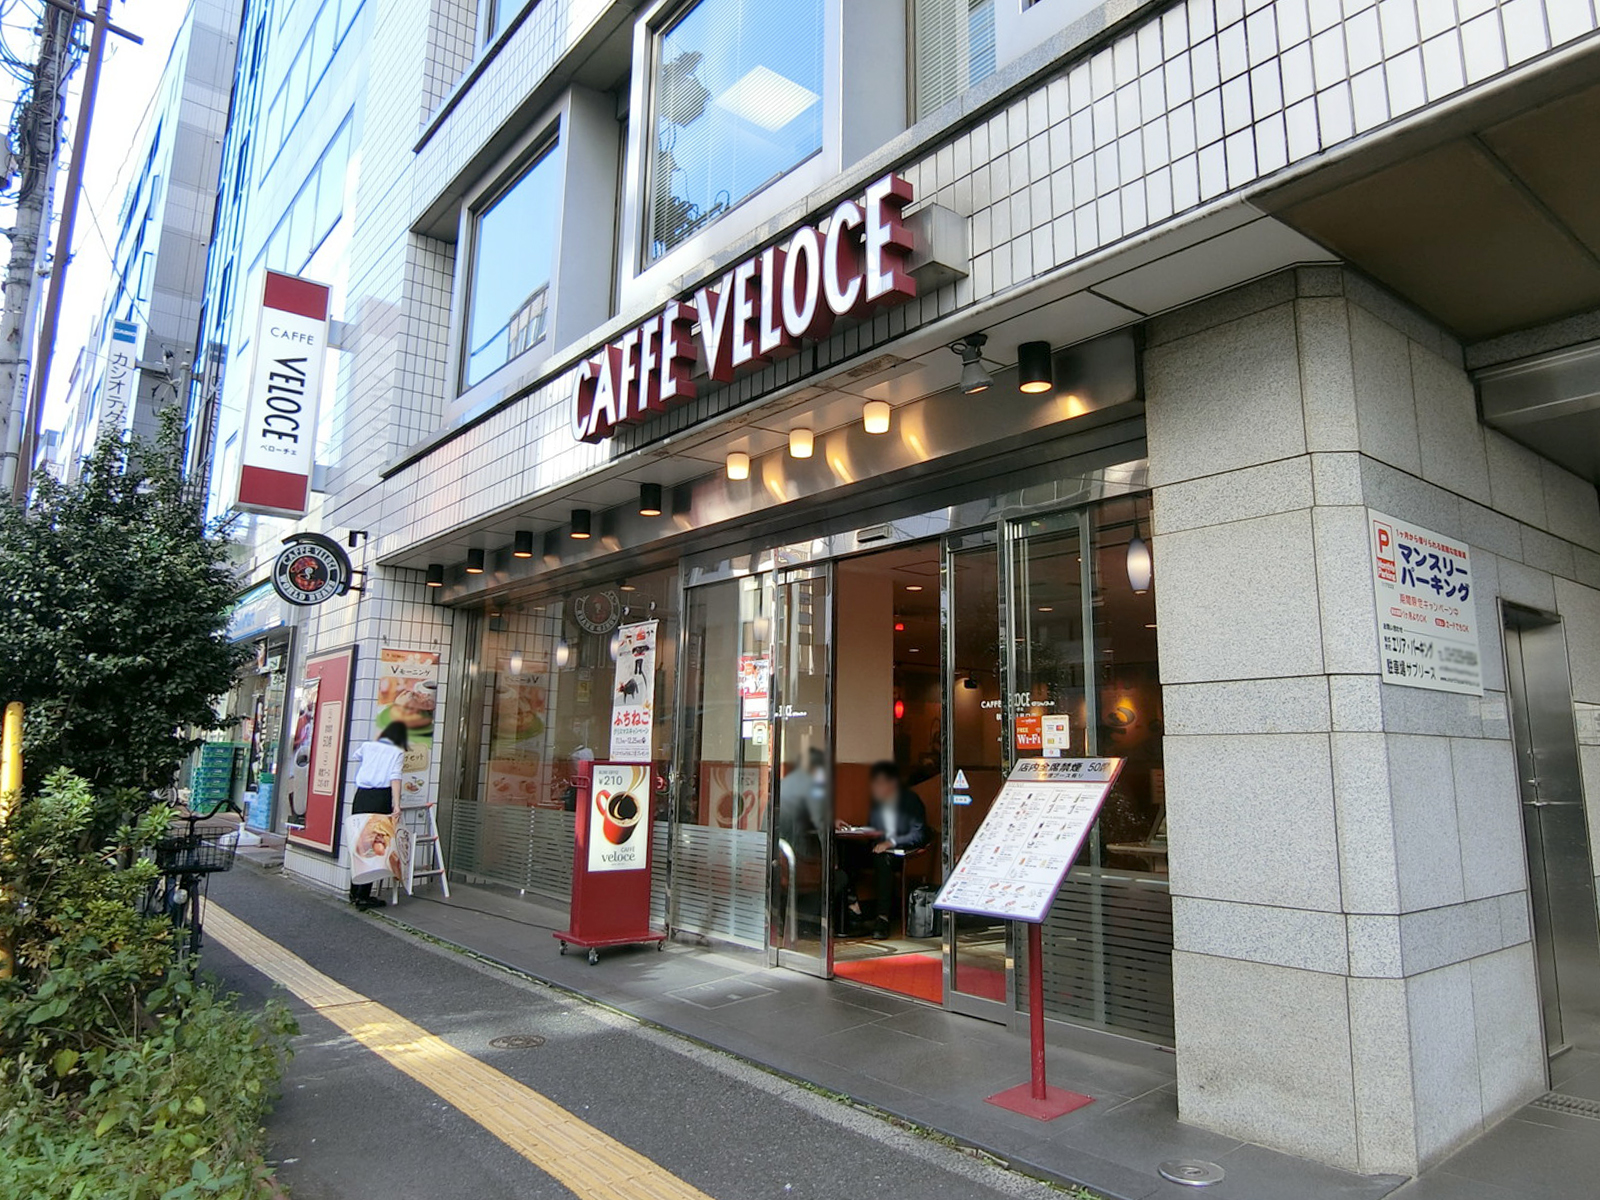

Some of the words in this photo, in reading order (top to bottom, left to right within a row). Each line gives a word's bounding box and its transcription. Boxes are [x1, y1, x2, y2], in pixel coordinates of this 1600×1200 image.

[694, 172, 896, 381] VELOCE
[262, 357, 308, 444] VELOCE
[260, 444, 297, 456] ベローチェ
[1398, 543, 1468, 577] マンスリー
[280, 574, 306, 600] WORLD
[309, 580, 336, 601] BEANS
[1401, 566, 1470, 602] パーキング
[614, 711, 649, 726] ふちねこ
[1017, 762, 1083, 772] 店内全席禁煙
[599, 775, 623, 786] ¥210
[602, 851, 636, 863] veloce
